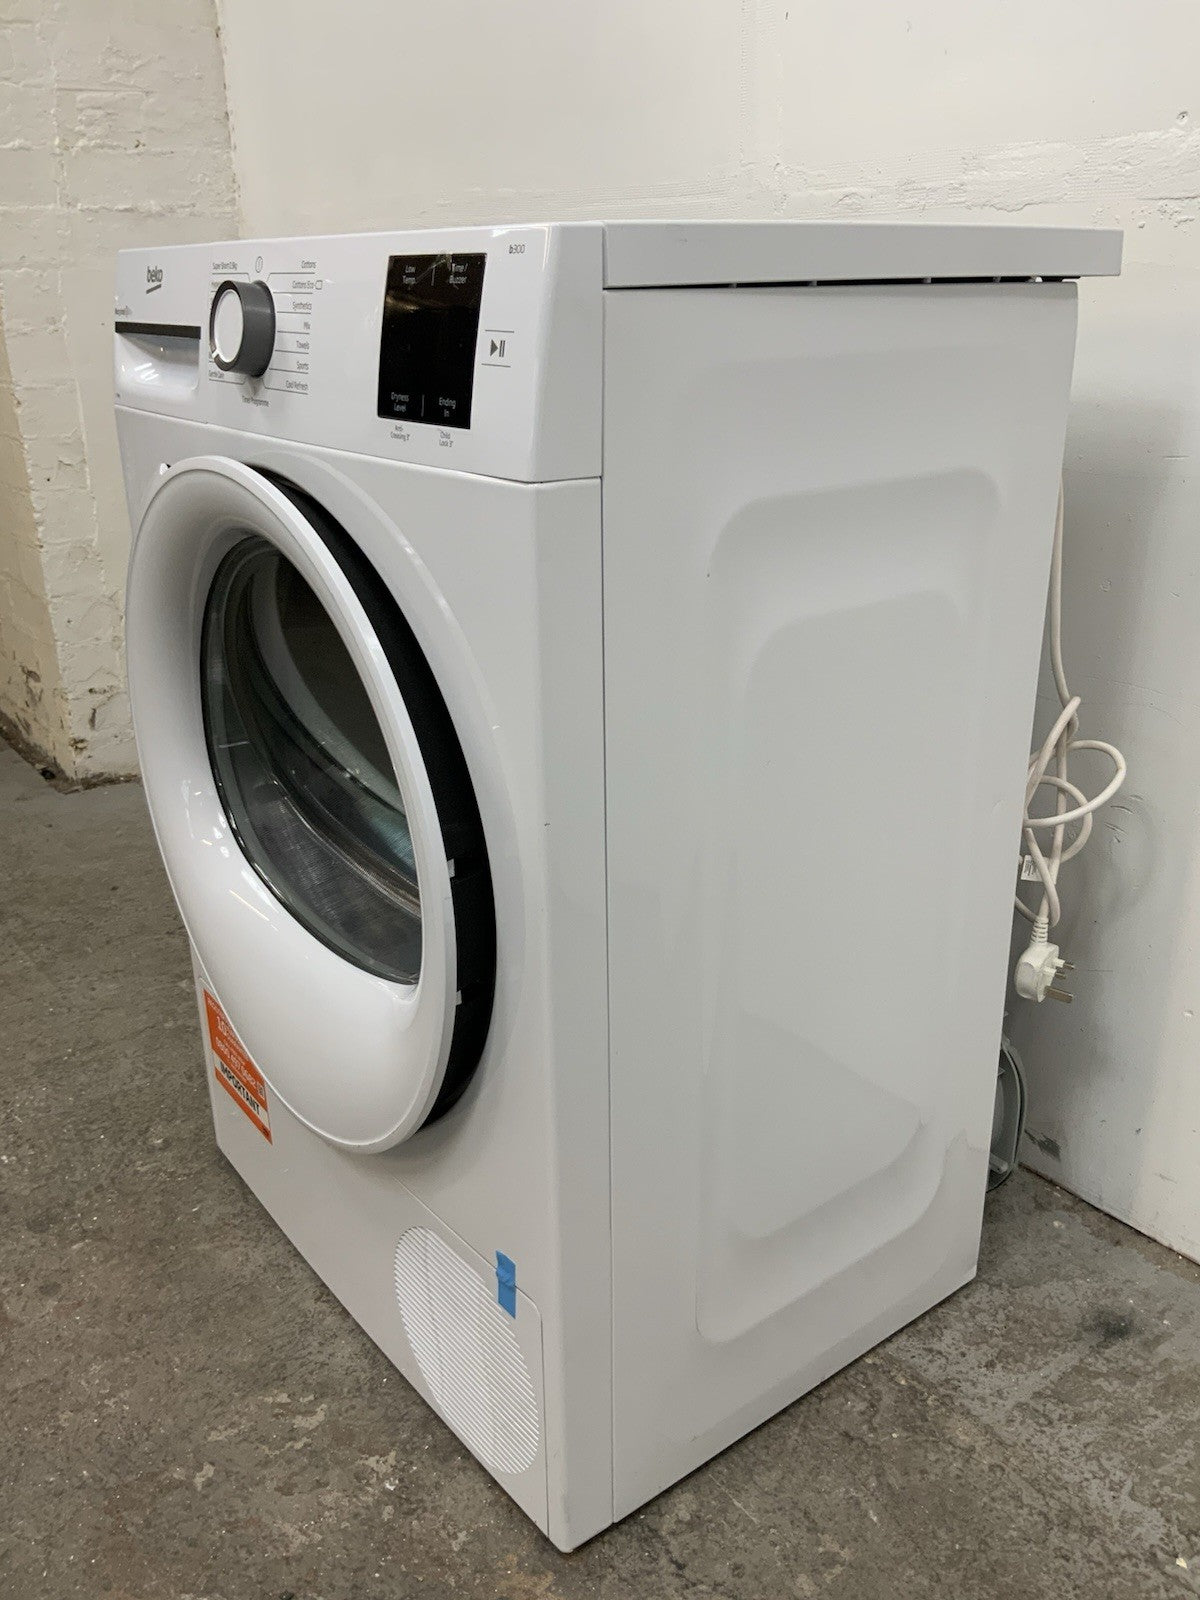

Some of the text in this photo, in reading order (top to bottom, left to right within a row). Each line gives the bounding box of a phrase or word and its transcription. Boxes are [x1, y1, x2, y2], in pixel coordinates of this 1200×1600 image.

[301, 260, 316, 268] Cottons
[146, 266, 163, 282] beko
[292, 302, 312, 312] Synthetics
[296, 361, 309, 370] Sports
[391, 392, 410, 402] Dryness
[394, 402, 406, 412] Level
[439, 396, 456, 410] Ending
[220, 1060, 260, 1115] IMPORTANT
